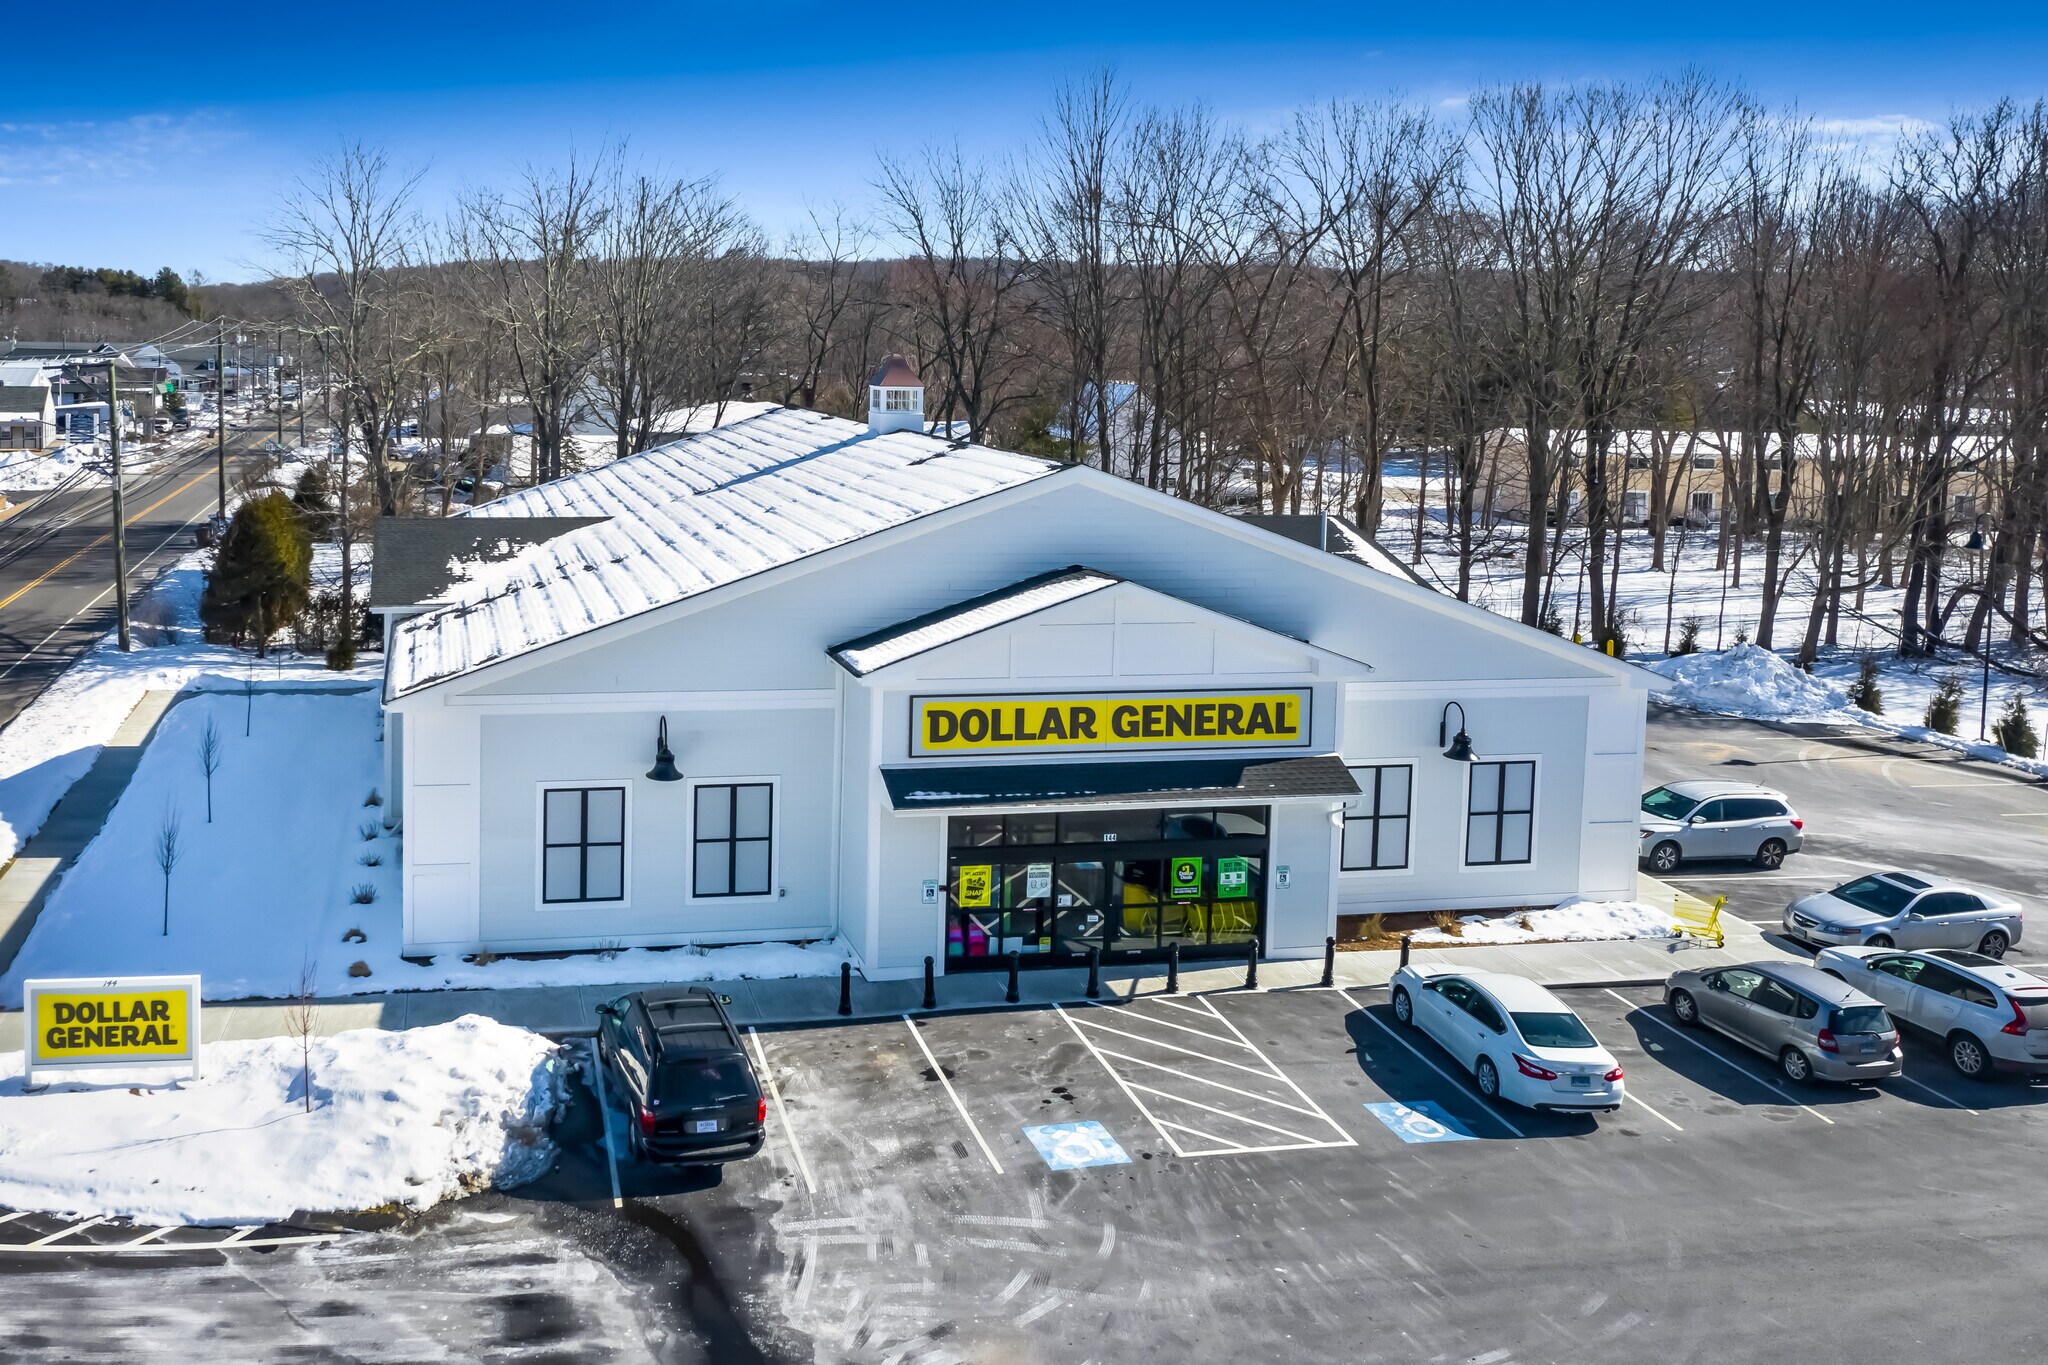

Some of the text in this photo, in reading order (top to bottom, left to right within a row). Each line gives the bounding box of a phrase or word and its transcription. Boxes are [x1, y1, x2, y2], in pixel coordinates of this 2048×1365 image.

[927, 702, 1297, 743] DOLLAR GENERAL
[1104, 834, 1117, 842] 144
[965, 889, 983, 897] SNAP
[53, 1000, 170, 1024] DOLLAR
[46, 1024, 178, 1049] GENERAL
